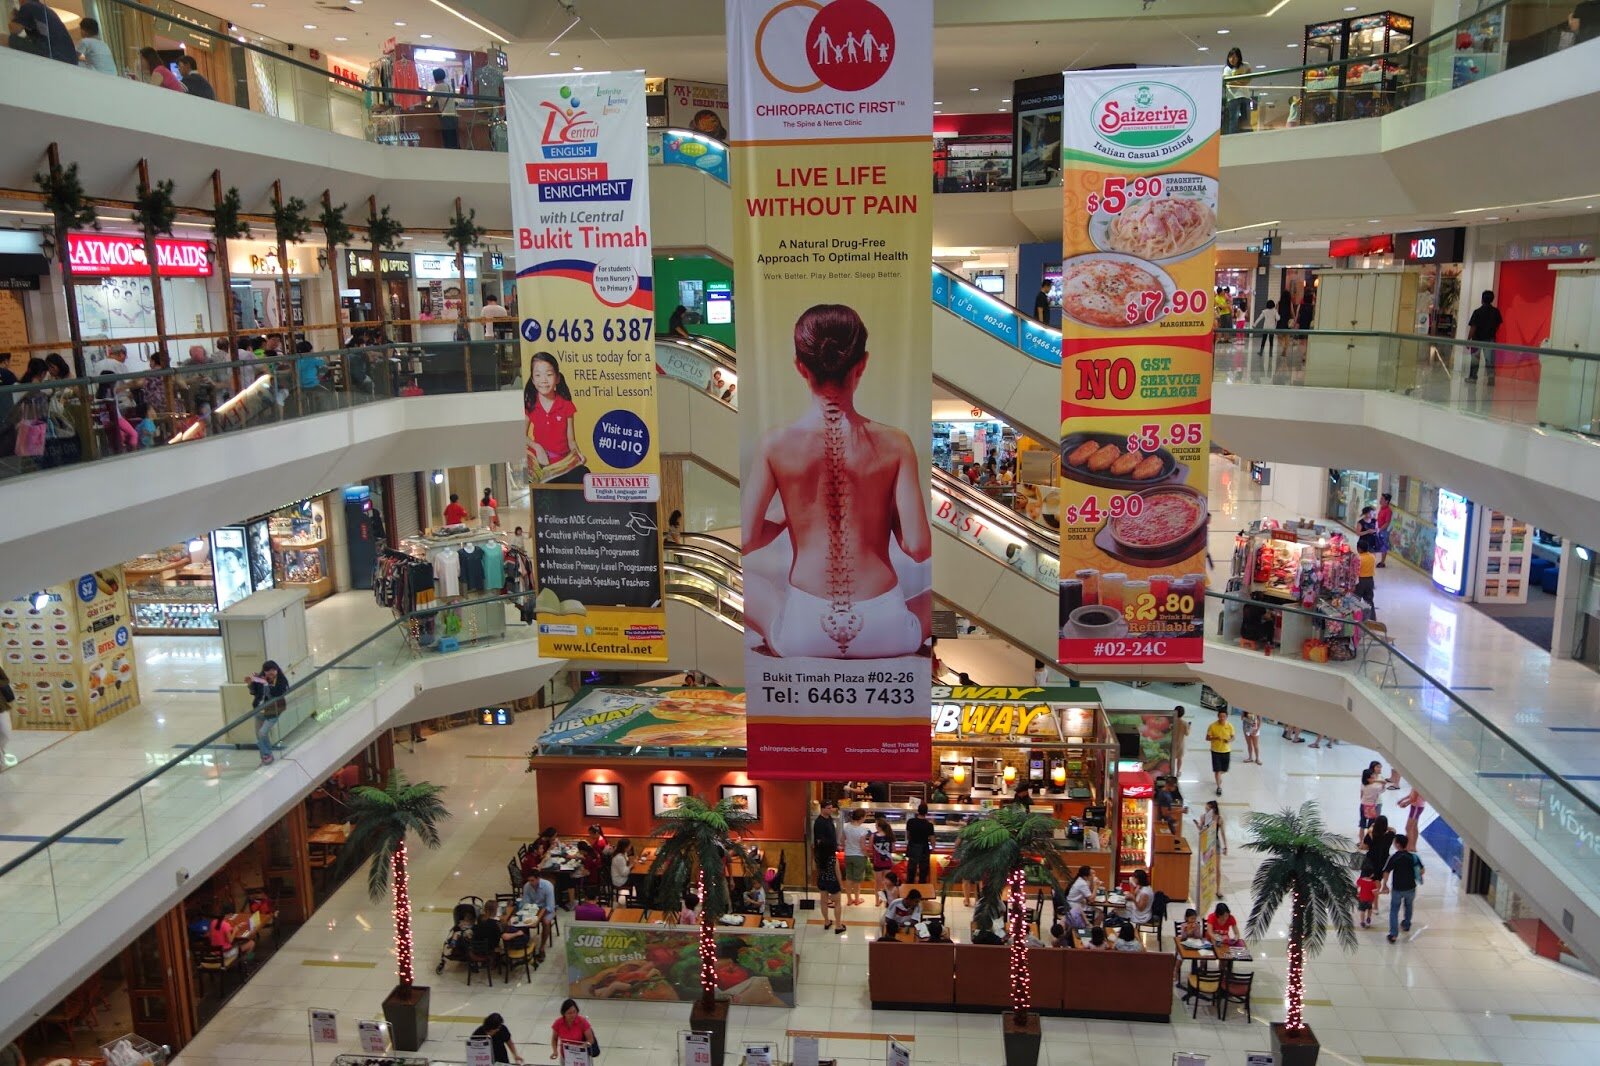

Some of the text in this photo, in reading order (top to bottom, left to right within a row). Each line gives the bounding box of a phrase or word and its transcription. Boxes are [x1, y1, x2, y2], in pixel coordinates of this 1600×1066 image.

[756, 101, 895, 116] CHIROPRACTIC FIRST
[1099, 101, 1188, 131] Saizeriya
[550, 146, 592, 156] ENGLISH
[1093, 135, 1193, 159] Italian Casual Dining
[539, 168, 598, 182] ENGLISH
[777, 166, 886, 187] LIVE LIFE
[544, 182, 627, 199] ENRICHMENT
[1088, 178, 1162, 214] $5.90
[746, 195, 917, 217] WITHOUT PAIN
[540, 210, 624, 224] with LCentral
[520, 225, 646, 250] Bukit Timah
[779, 238, 886, 250] A Natural Drug-Free
[1417, 238, 1436, 258] DBS
[156, 244, 207, 267] MAIDS
[757, 251, 908, 264] Approach To Optimal Health
[389, 260, 409, 272] OPTICS
[810, 272, 827, 280] Play
[855, 272, 876, 280] Sleep
[1126, 290, 1207, 323] $7.90
[546, 318, 652, 342] 6463 6387
[984, 315, 1011, 334] #02-01C
[1032, 336, 1049, 350] 6466
[558, 350, 579, 362] Visit
[582, 354, 593, 362] us
[596, 351, 624, 366] today
[627, 350, 640, 362] for
[1141, 358, 1171, 371] GST
[668, 355, 704, 378] FOCUS
[574, 370, 651, 380] FREE Assessment
[1076, 358, 1136, 400] NO
[1141, 374, 1200, 386] SERVICE
[574, 386, 652, 397] and Trial Lesson!
[1141, 386, 1197, 398] CHARGE
[602, 422, 643, 438] Visit us at
[1128, 424, 1202, 452] $3.95
[598, 436, 643, 456] #01-01Q
[592, 478, 649, 488] INTENSIVE
[1067, 495, 1143, 524] $4.90
[544, 515, 568, 524] Follows
[587, 516, 620, 525] Curriculum
[936, 498, 989, 539] BEST
[545, 530, 636, 543] Creative Writing Programmes
[546, 545, 640, 558] Intensive Reading Programmes
[547, 560, 657, 574] Intensive Primary Level Programmes
[548, 576, 650, 589] Native English Speaking Teachers
[1125, 594, 1194, 620] $2.80
[1129, 622, 1194, 632] Refillable
[117, 633, 126, 643] $2
[98, 640, 116, 654] BITES
[553, 643, 652, 654] www.LCentral.net
[1094, 642, 1166, 656] #02-24C
[763, 672, 914, 683] Bukit Timah Plaza #02-26
[762, 686, 914, 704] Tel: 6463 7433
[931, 686, 1045, 699] BWAY
[539, 704, 644, 738] SUBWAY
[931, 703, 1052, 735] BWAY
[760, 746, 827, 754] chiropractic-first.org
[574, 935, 637, 949] SUBWAY
[585, 950, 646, 964] eat fresh.
